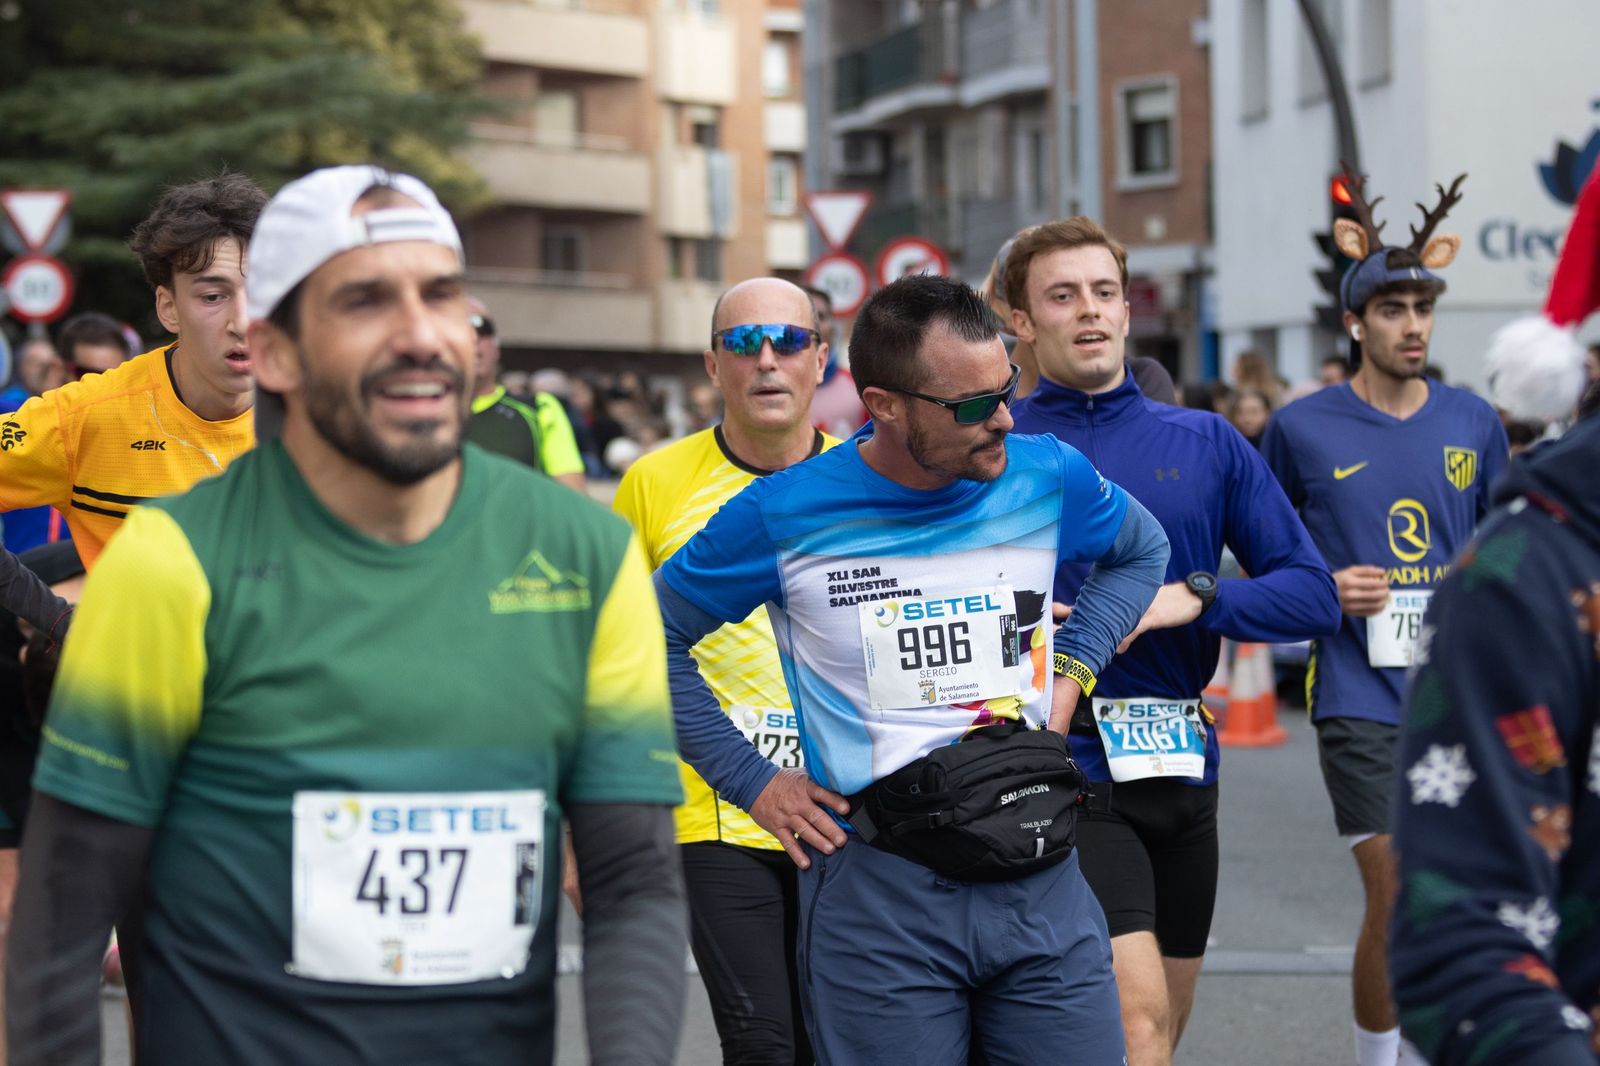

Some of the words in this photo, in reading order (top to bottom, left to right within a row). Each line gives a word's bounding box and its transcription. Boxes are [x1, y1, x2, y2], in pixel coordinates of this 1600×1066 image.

[130, 439, 167, 451] 42K
[827, 570, 849, 582] XLI
[852, 566, 881, 579] SAN
[828, 578, 898, 595] SILVESTRE
[903, 594, 1001, 621] SETEL
[897, 621, 972, 671] 996
[919, 667, 958, 678] SERGIO
[938, 682, 979, 693] Ayuntamiento
[948, 691, 980, 700] Salamanca
[1112, 716, 1188, 751] 2067
[1000, 784, 1050, 806] SALOMON
[371, 806, 519, 833] SETEL
[355, 848, 468, 915] 437
